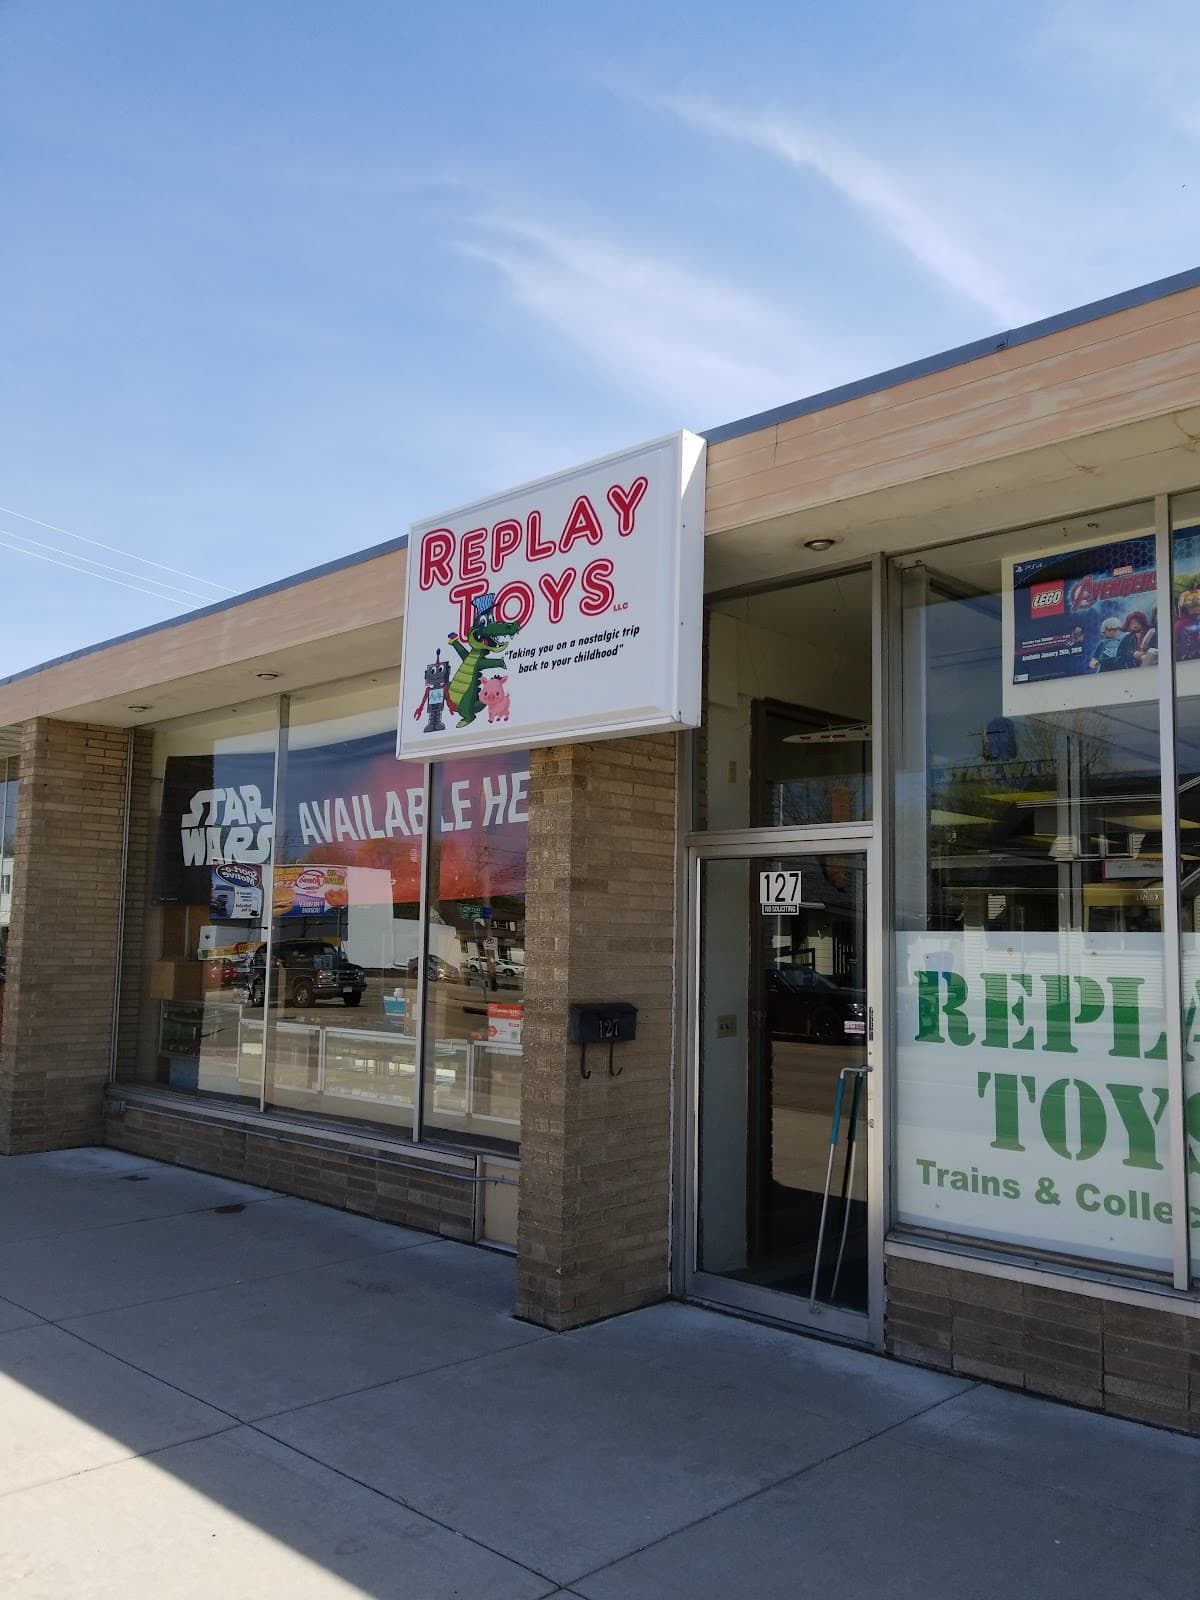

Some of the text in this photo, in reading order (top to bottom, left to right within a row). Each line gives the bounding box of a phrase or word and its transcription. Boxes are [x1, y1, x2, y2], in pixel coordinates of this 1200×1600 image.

[419, 476, 648, 591] REPLAY
[449, 558, 629, 643] TOYS LLC
[1032, 589, 1063, 608] LEGO
[538, 644, 554, 657] you
[556, 641, 567, 651] on
[569, 640, 576, 648] a
[578, 629, 620, 646] nostalgic
[622, 625, 640, 638] trip
[518, 662, 538, 674] back
[540, 660, 549, 669] to
[551, 657, 571, 669] your
[181, 784, 273, 827] STAR
[482, 771, 530, 827] HE
[181, 823, 273, 867] WARS
[764, 873, 799, 902] 127
[600, 1018, 619, 1039] 127
[916, 1158, 1021, 1200] Trains
[1034, 1177, 1061, 1207] &
